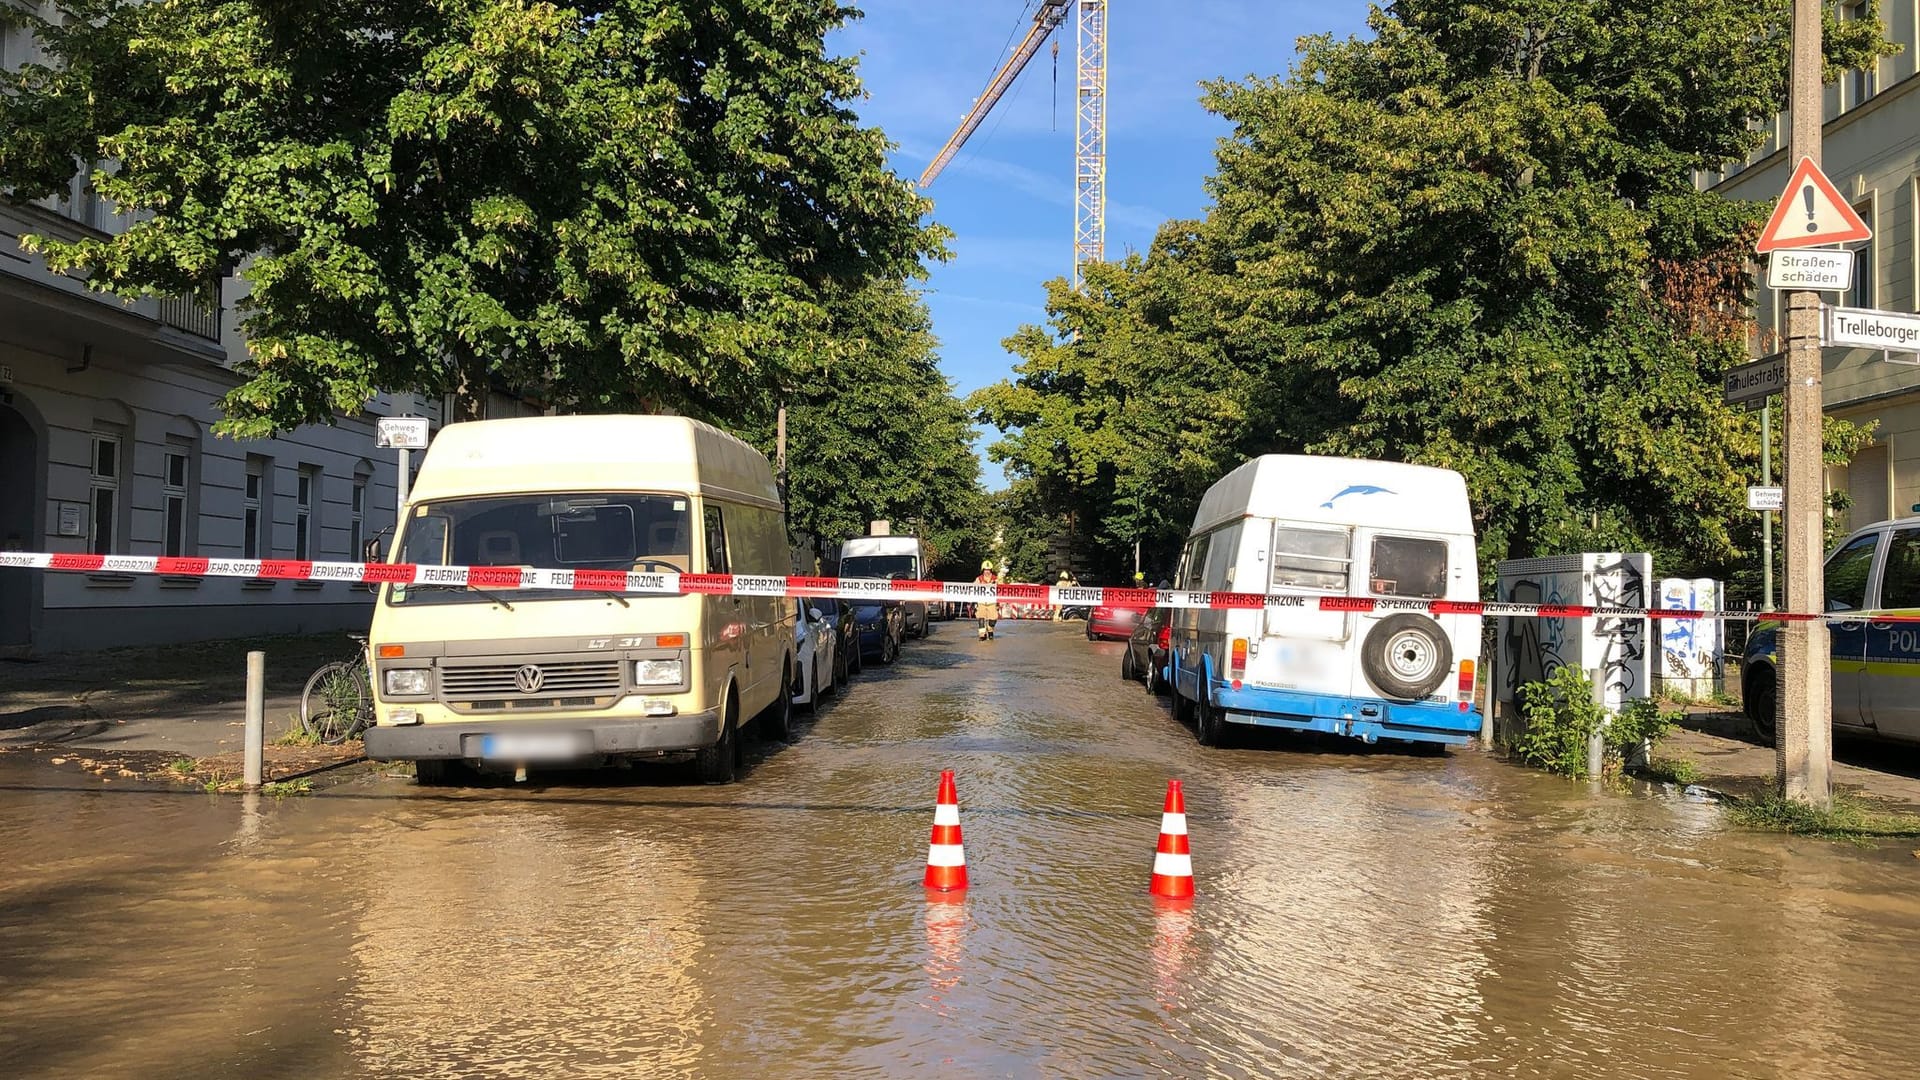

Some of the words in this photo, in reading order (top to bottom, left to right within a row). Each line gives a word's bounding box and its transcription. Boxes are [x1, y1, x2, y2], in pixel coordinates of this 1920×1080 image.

[1781, 255, 1842, 268] Straßen-
[1781, 270, 1838, 283] schäden
[1837, 316, 1919, 344] Trelleborger
[48, 557, 160, 570] FEUERWEHR-SPERRZONE
[175, 561, 286, 576] FEUERWEHR-SPERRZONE
[298, 565, 411, 580] FEUERWEHR-SPERRZONE
[424, 569, 537, 584] FEUERWEHR-SPERRZONE
[551, 572, 664, 588] FEUERWEHR-SPERRZONE
[678, 576, 791, 592] FEUERWEHR-SPERRZONE
[1058, 589, 1173, 604] FEUERWEHR-SPERRZONE
[1188, 593, 1305, 607] FEUERWEHR-SPERRZONE
[1320, 597, 1437, 611] FEUERWEHR-SPERRZONE
[587, 639, 611, 649] LT
[618, 637, 643, 648] 31
